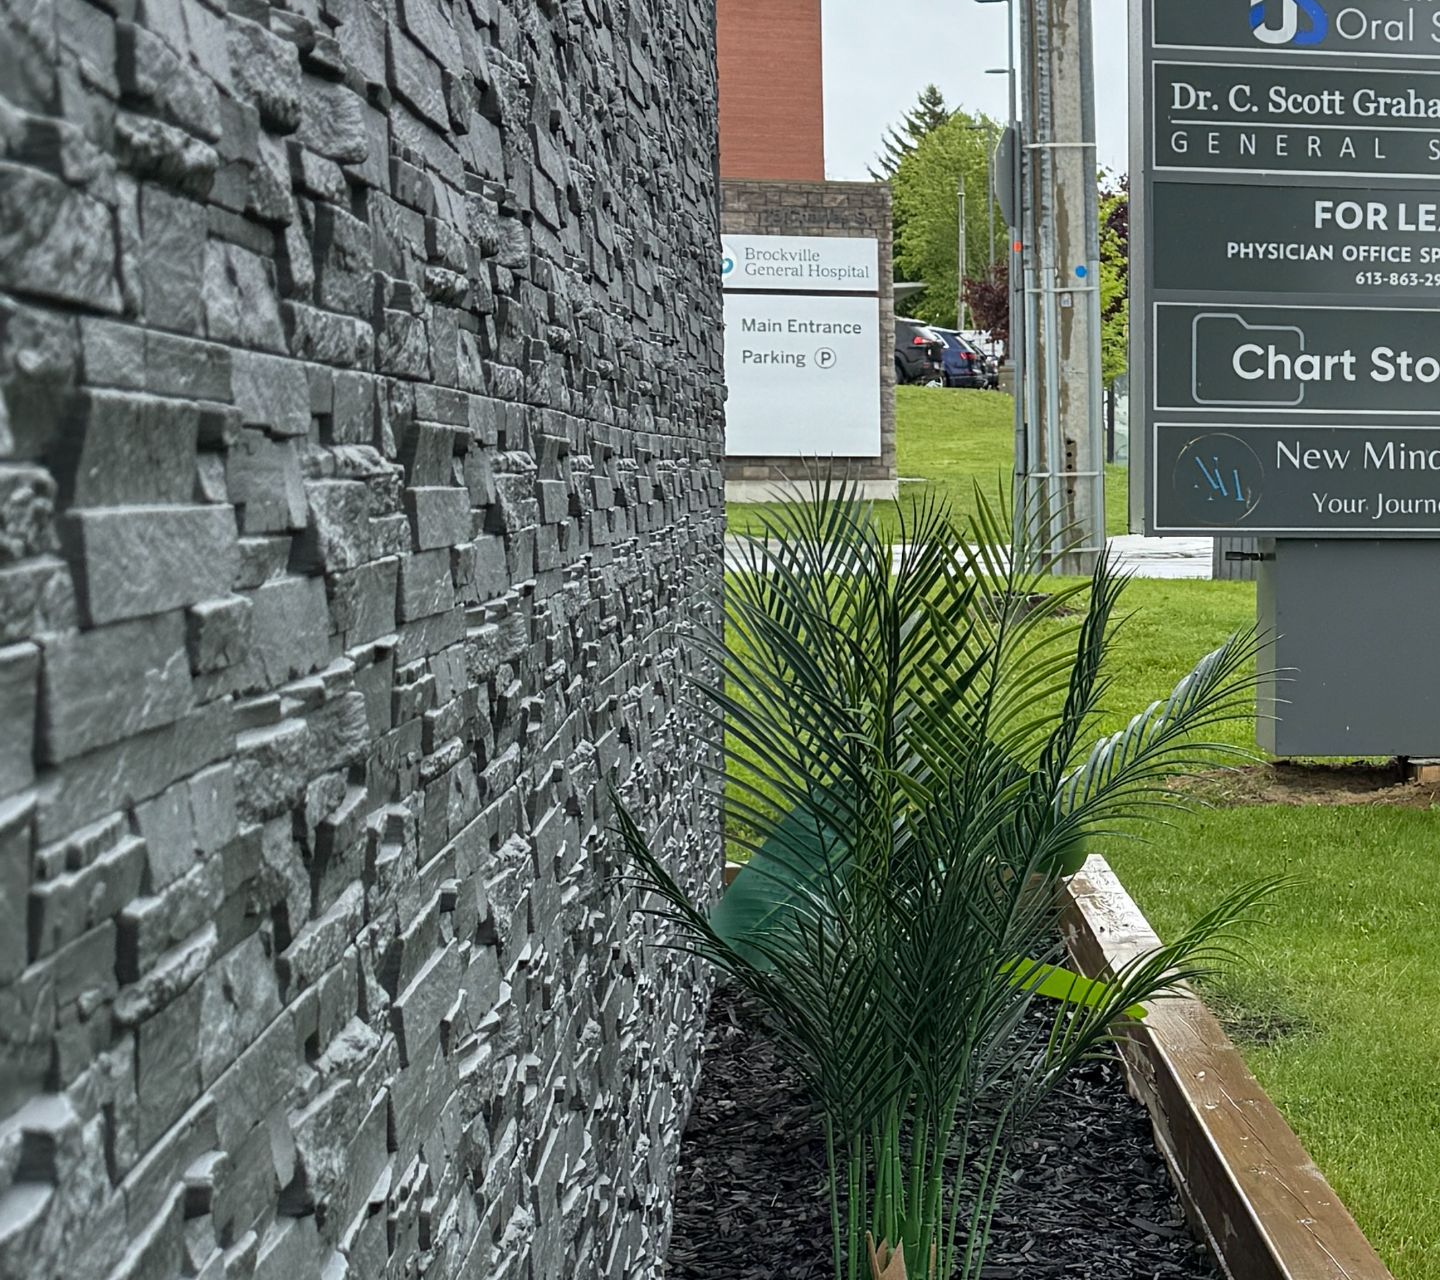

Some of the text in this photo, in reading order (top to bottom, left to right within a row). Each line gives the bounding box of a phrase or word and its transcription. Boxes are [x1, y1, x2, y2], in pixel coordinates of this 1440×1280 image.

[1335, 7, 1414, 42] Oral
[1170, 82, 1219, 111] Dr.
[1228, 84, 1259, 113] C.
[1268, 85, 1345, 115] Scott
[1171, 131, 1387, 159] GENERAL
[1314, 200, 1389, 231] FOR
[744, 246, 821, 262] Brockville
[1227, 241, 1334, 261] PHYSICIAN
[1342, 245, 1412, 263] OFFICE
[744, 262, 870, 281] General Hospital
[741, 318, 862, 335] Main Entrance
[742, 349, 832, 368] Parking P
[1231, 341, 1357, 383] Chart
[1276, 440, 1351, 470] New
[1312, 492, 1367, 514] Your
